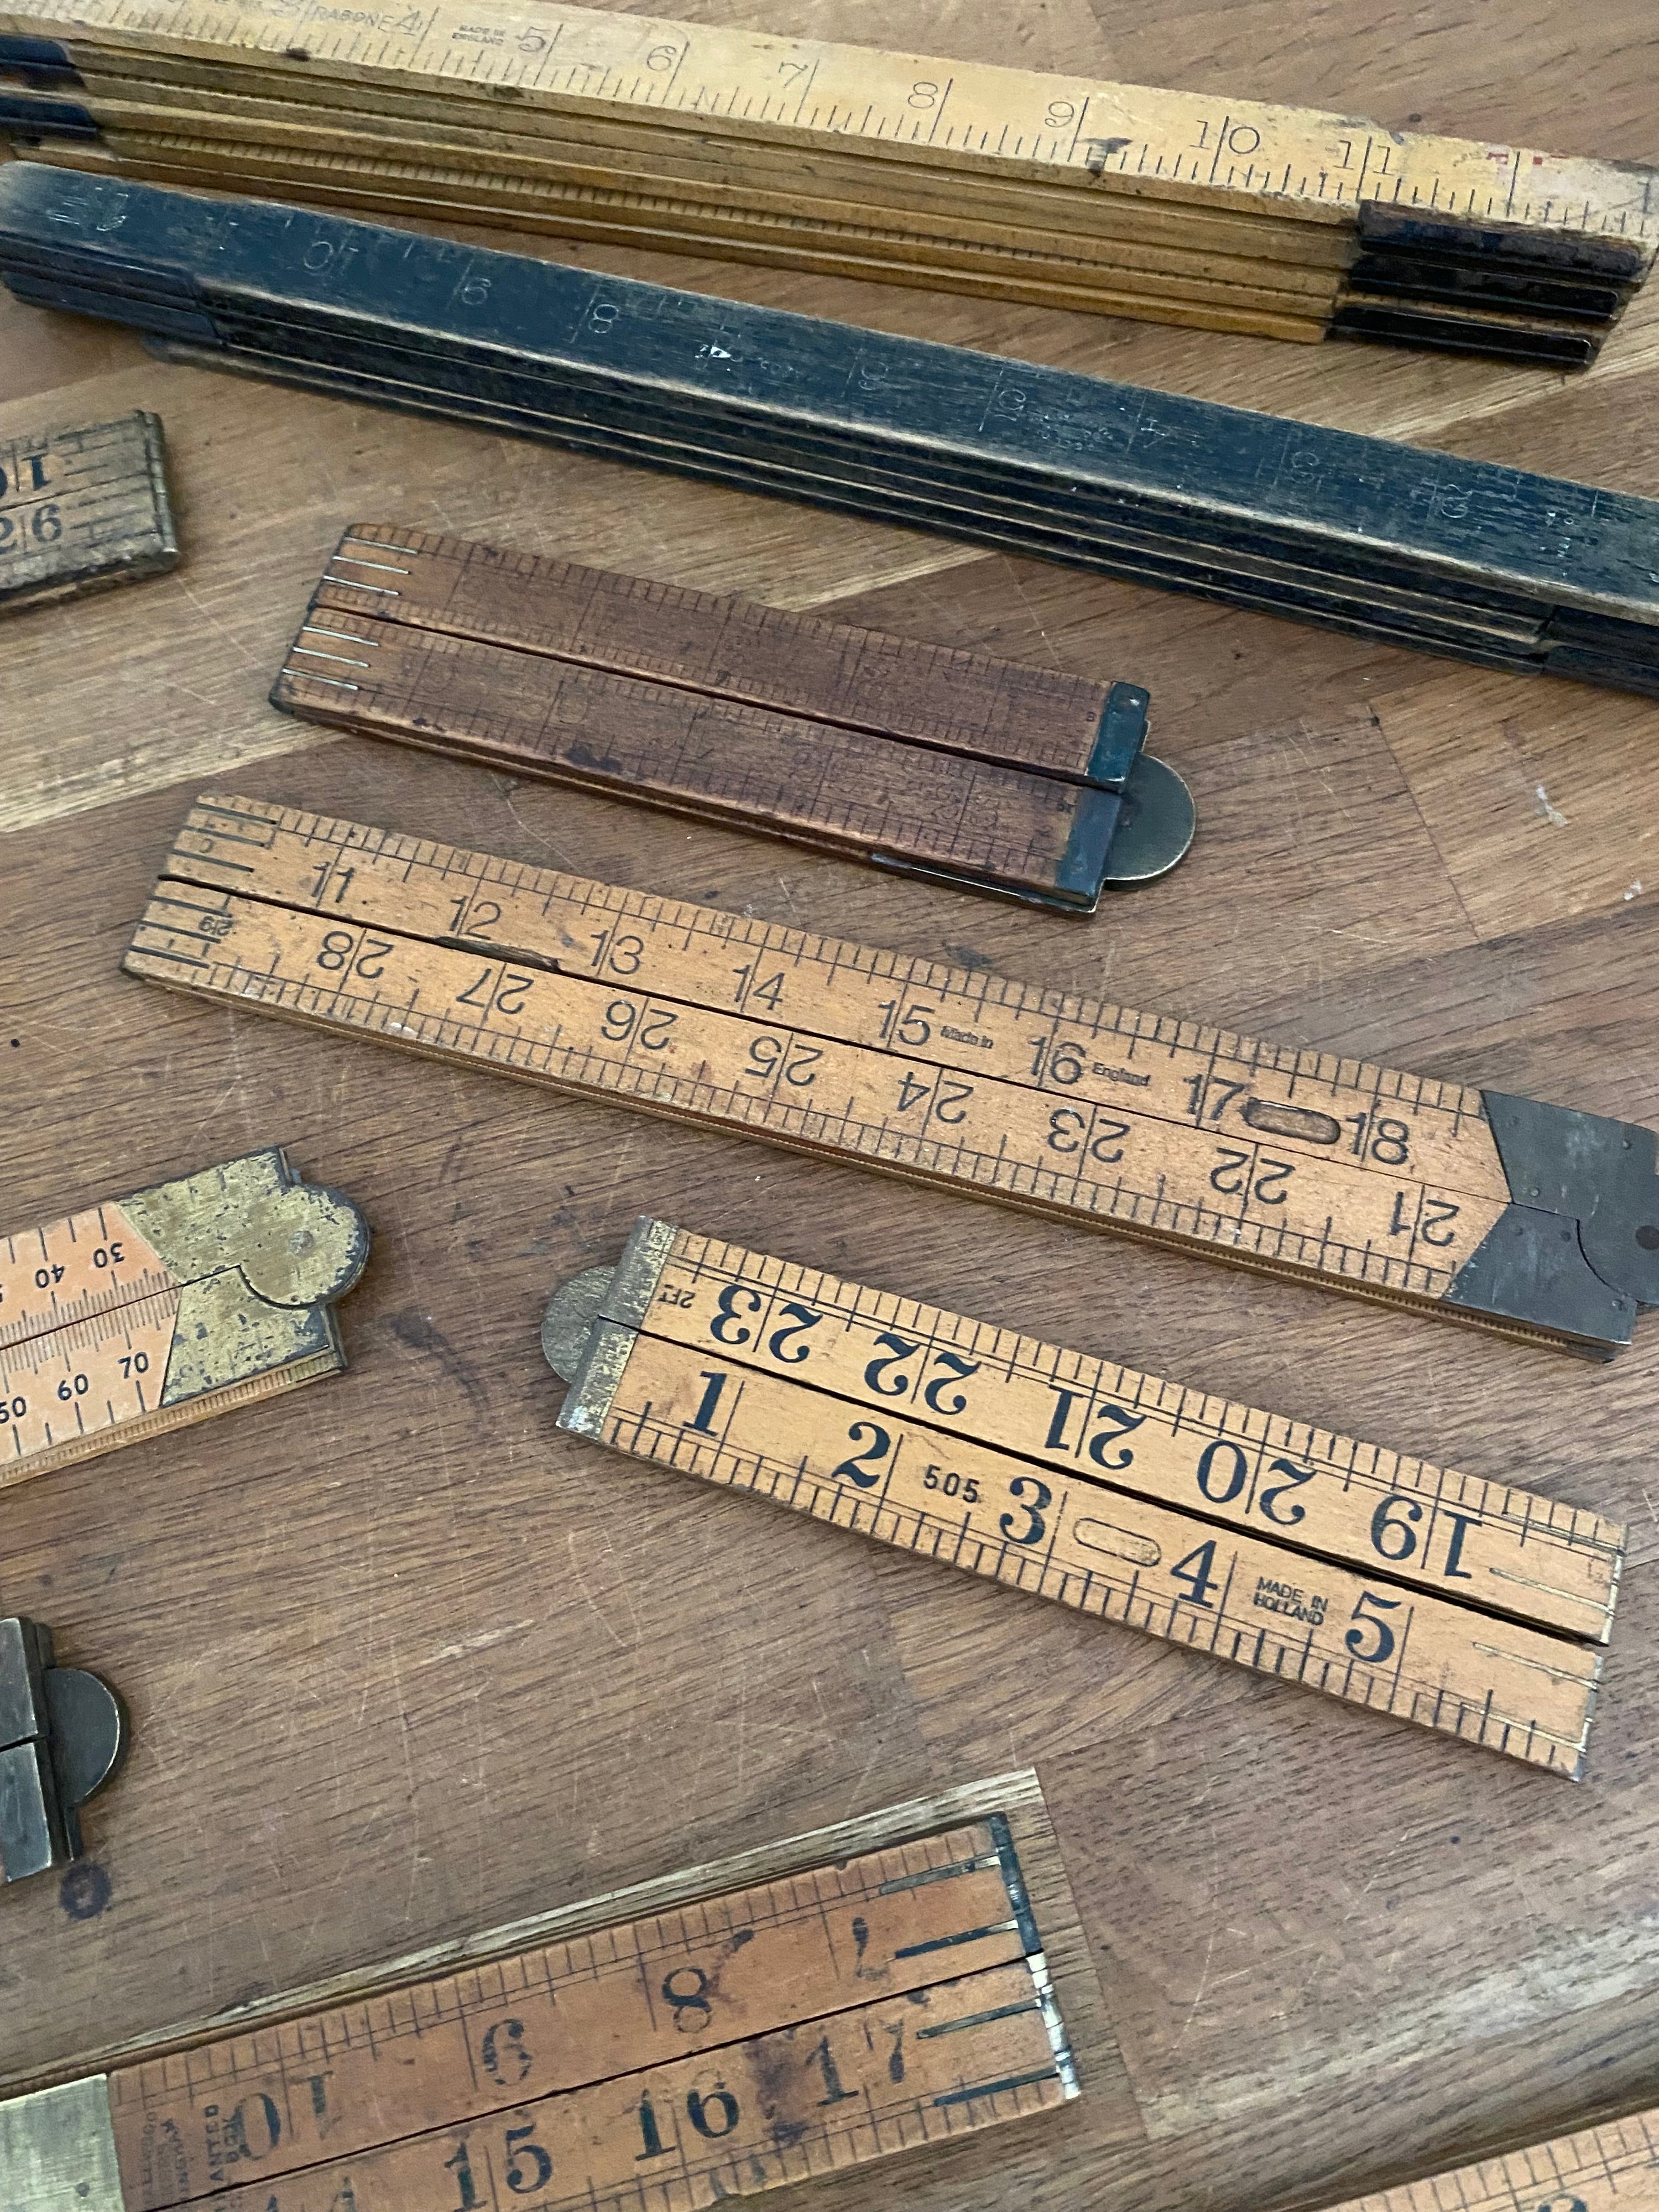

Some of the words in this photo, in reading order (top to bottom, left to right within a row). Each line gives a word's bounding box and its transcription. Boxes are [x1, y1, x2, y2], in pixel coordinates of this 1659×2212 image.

[517, 26, 550, 52] 5
[646, 44, 676, 72] 6
[778, 60, 808, 90] 7
[907, 81, 938, 109] 8
[1044, 101, 1074, 128] 9
[1189, 119, 1261, 154] 10
[1332, 139, 1394, 176] 11
[588, 303, 619, 334] 8
[312, 861, 355, 903] 11
[450, 895, 501, 940] 12
[316, 931, 395, 979] 28
[591, 930, 644, 974] 13
[456, 968, 534, 1015] 27
[733, 964, 785, 1011] 14
[601, 1000, 679, 1050] 26
[878, 999, 935, 1046] 15
[744, 1036, 823, 1087] 25
[1028, 1036, 1087, 1085] 16
[897, 1071, 974, 1124] 24
[1183, 1074, 1248, 1121] 17
[1047, 1109, 1131, 1163] 23
[1345, 1112, 1410, 1165] 18
[1209, 1147, 1296, 1206] 22
[1389, 1191, 1460, 1248] 21
[35, 1264, 65, 1288] 40
[92, 1242, 126, 1269] 30
[709, 1284, 824, 1363] 23
[56, 1373, 89, 1402] 60
[117, 1352, 149, 1379] 70
[864, 1332, 982, 1416] 22
[682, 1370, 728, 1437] 1
[1044, 1383, 1148, 1470] 21
[831, 1421, 891, 1489] 2
[923, 1463, 980, 1504] 505
[1197, 1439, 1316, 1526] 20
[999, 1476, 1052, 1546] 3
[1370, 1494, 1483, 1579] 19
[1170, 1539, 1218, 1609] 4
[1256, 1576, 1305, 1604] MADE
[1311, 1595, 1328, 1613] IN
[1254, 1592, 1324, 1626] HOLLAND
[1344, 1589, 1401, 1663] 5
[661, 1966, 712, 2034] 8
[622, 2068, 740, 2162] 16
[444, 2125, 552, 2212] 15
